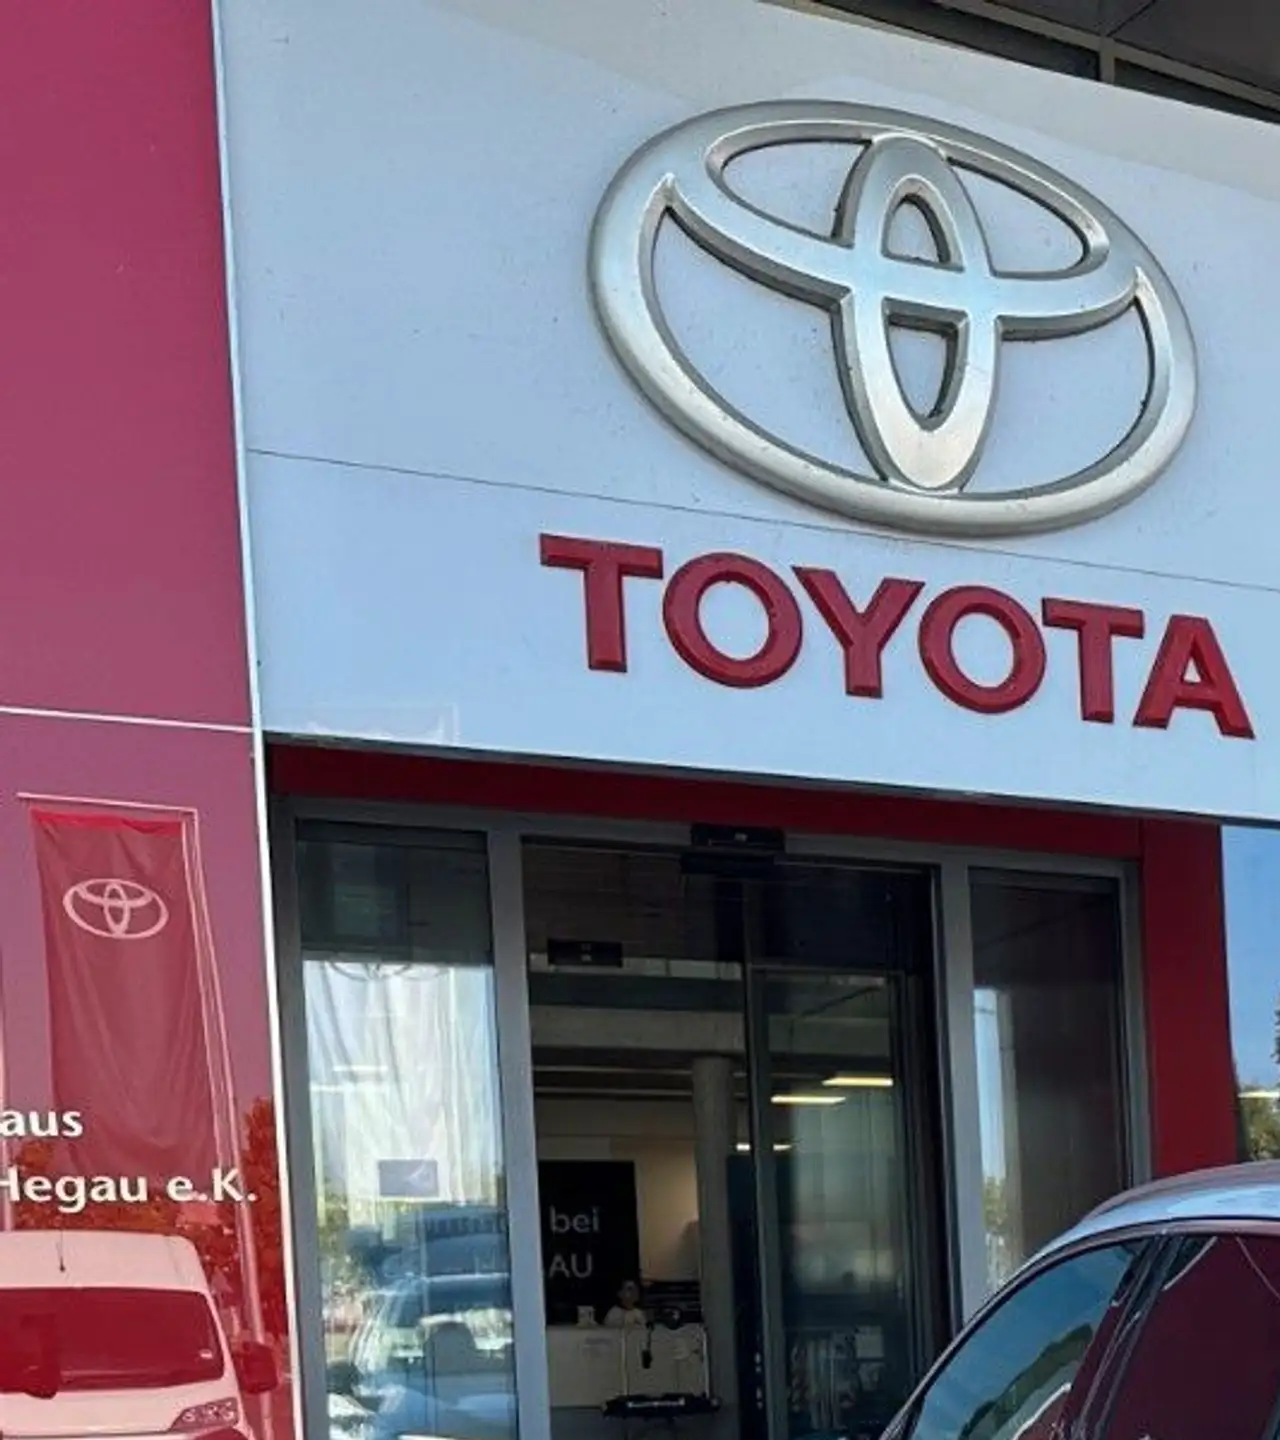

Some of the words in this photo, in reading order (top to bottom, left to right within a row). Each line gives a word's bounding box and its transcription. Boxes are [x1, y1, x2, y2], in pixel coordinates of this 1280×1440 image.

[538, 532, 1255, 740] TOYOTA
[166, 1167, 257, 1203] e.K.
[549, 1205, 600, 1234] bei
